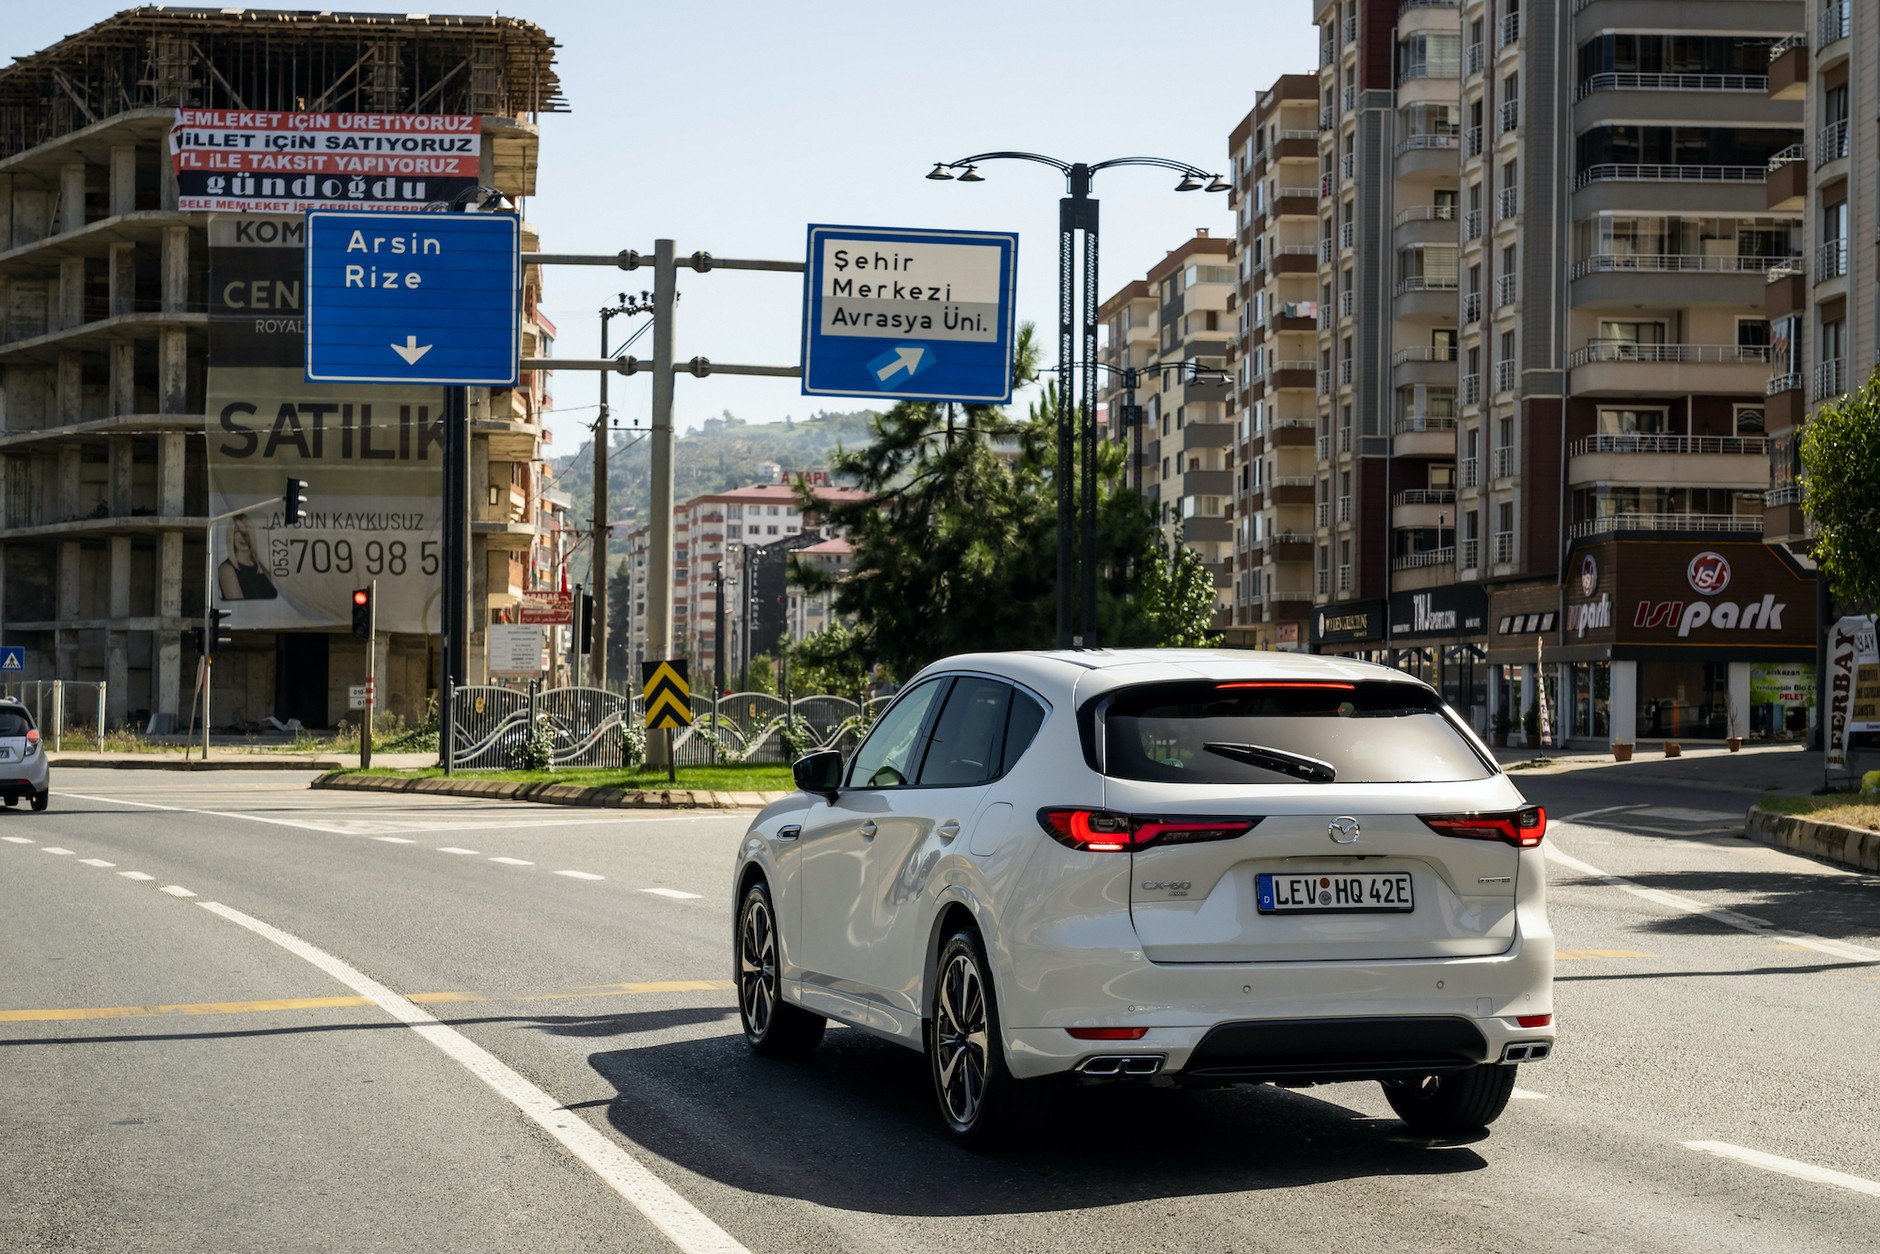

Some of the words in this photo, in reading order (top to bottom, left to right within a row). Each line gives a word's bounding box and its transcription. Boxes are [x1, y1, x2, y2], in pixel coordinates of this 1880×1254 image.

[325, 136, 473, 153] SATIYORUZ
[334, 156, 460, 174] YAPIYORUZ
[206, 172, 426, 200] gündoğdu
[235, 220, 304, 244] KOM
[346, 229, 441, 256] Arsin
[834, 250, 914, 272] Şehir
[345, 264, 422, 290] Rize
[832, 278, 951, 302] Merkezi
[223, 280, 300, 310] CEN
[255, 319, 305, 334] ROYAL
[832, 306, 932, 334] Avrasya
[943, 306, 988, 332] Üni.
[219, 401, 444, 462] SATILIK
[333, 512, 424, 531] KAYKUSUZ
[272, 538, 290, 578] 0532
[290, 539, 354, 575] 709
[366, 540, 408, 576] 98
[421, 541, 439, 576] 5
[1141, 879, 1192, 890] CX-60
[1274, 879, 1317, 905] LEV
[1335, 878, 1363, 904] HQ
[1369, 877, 1410, 903] 42E
